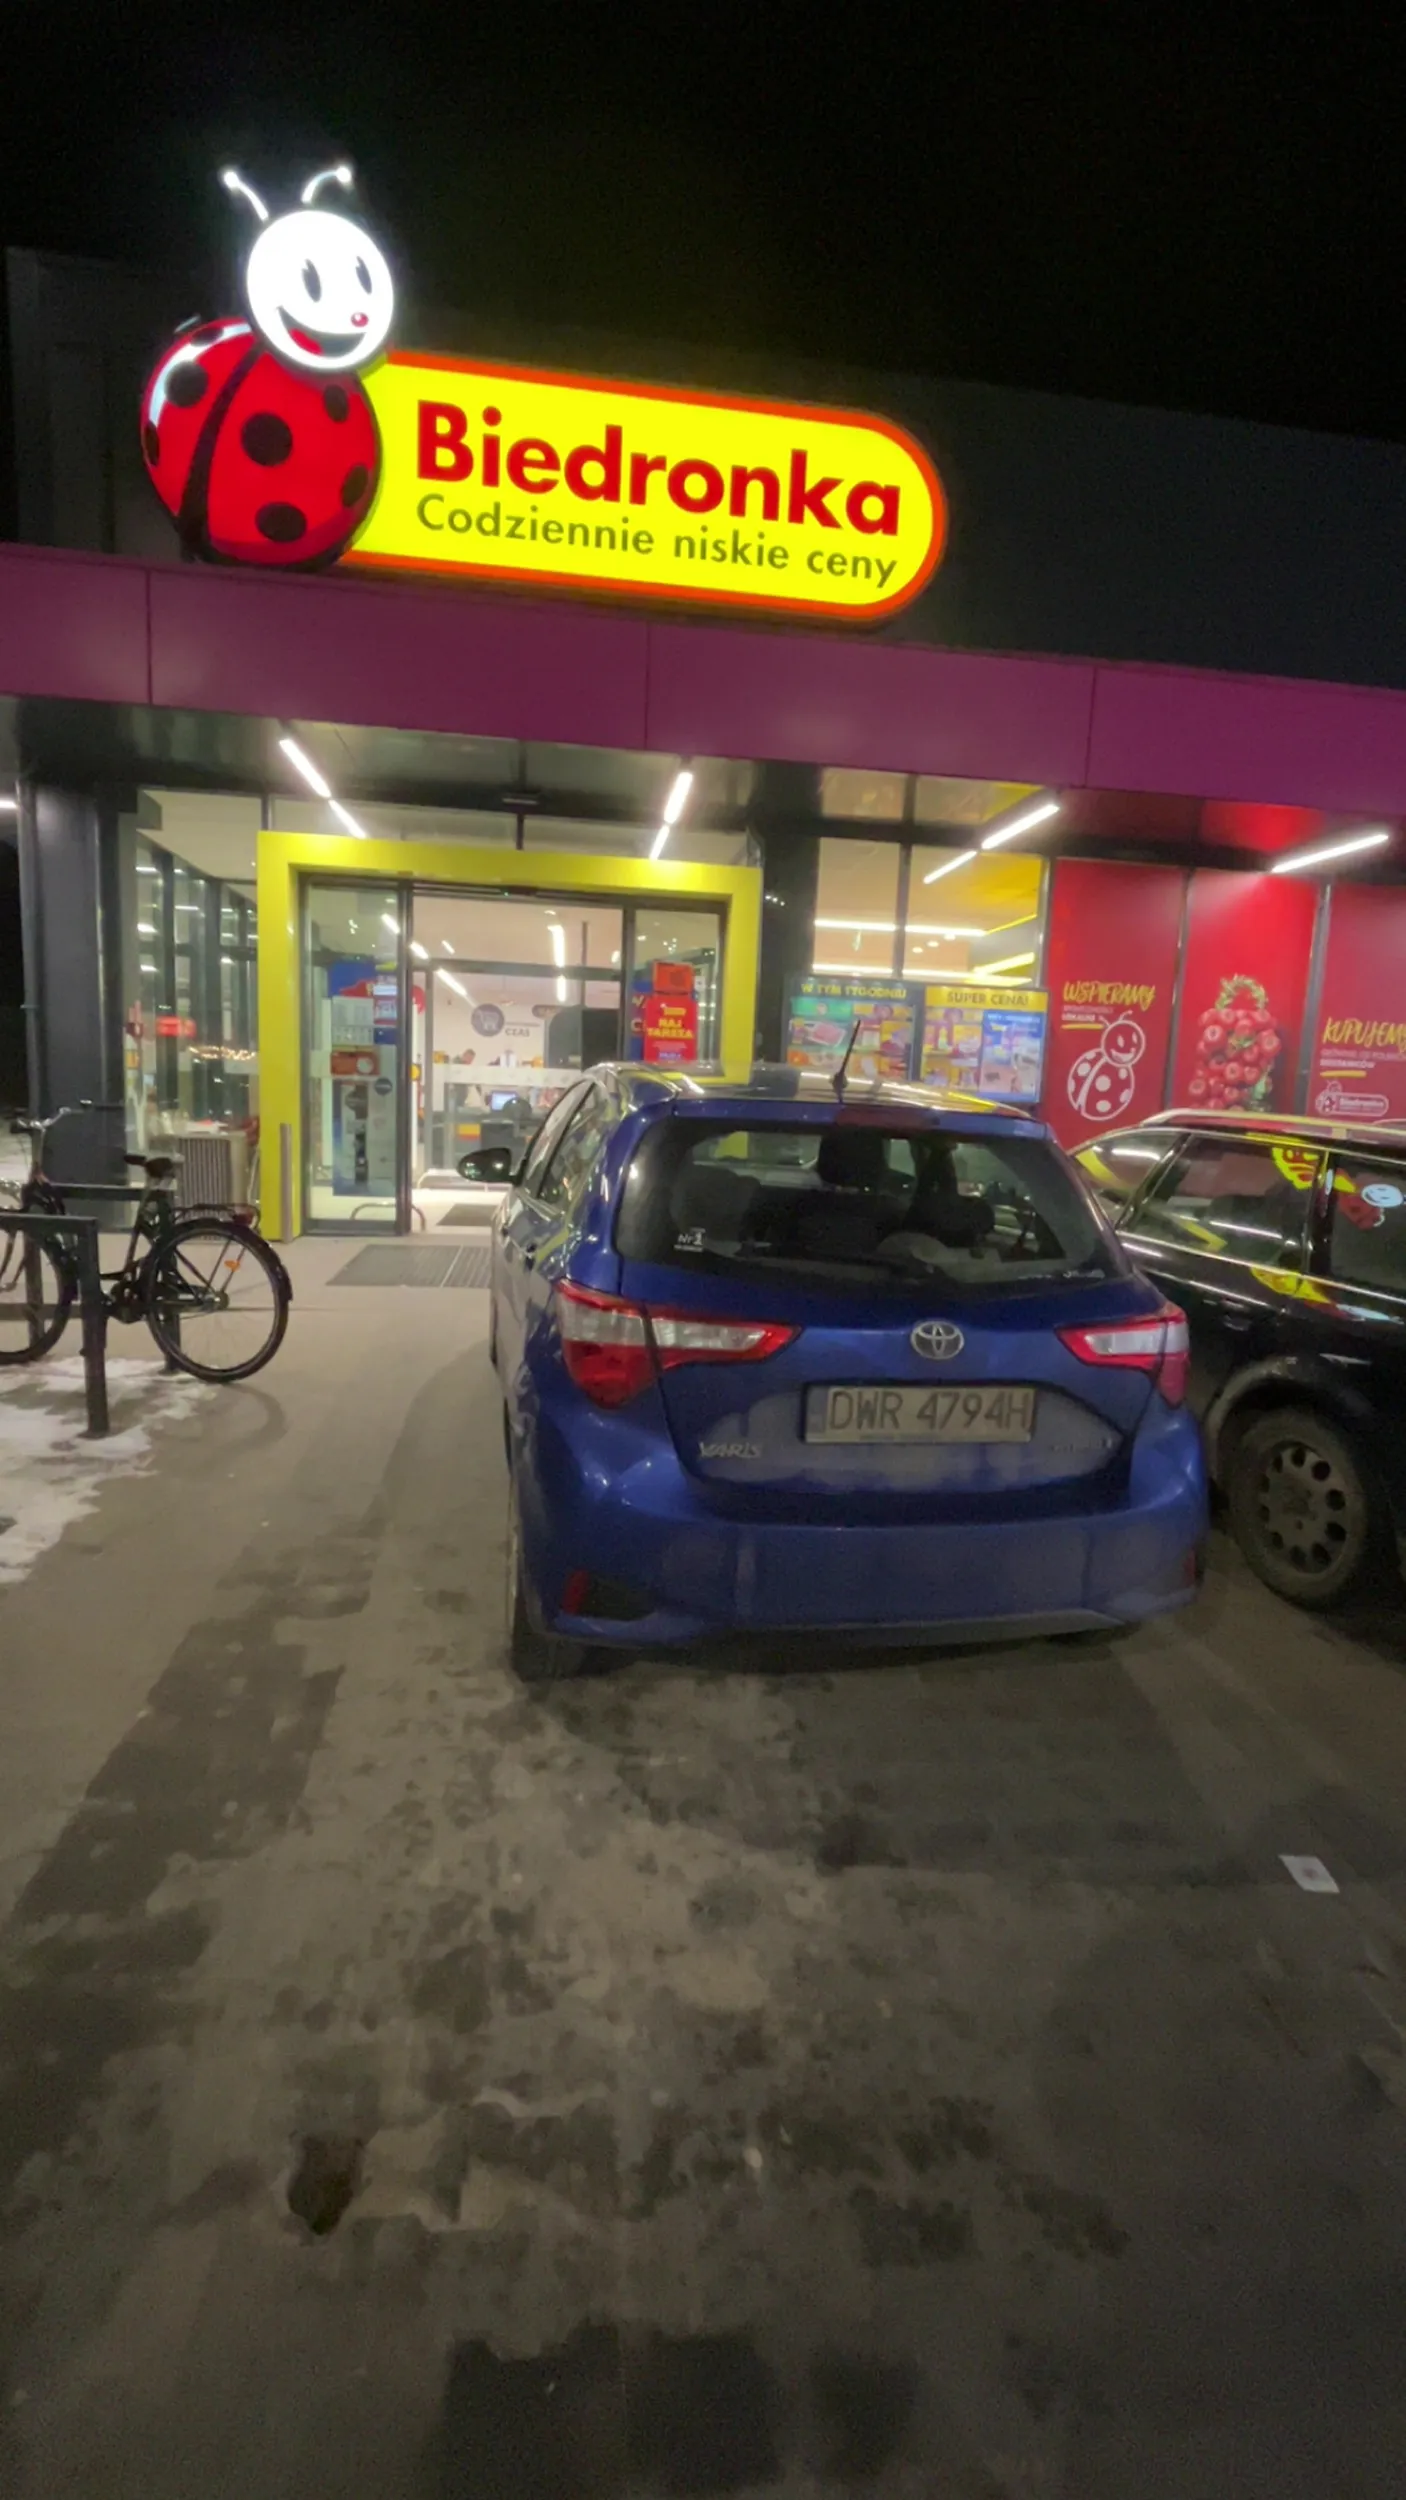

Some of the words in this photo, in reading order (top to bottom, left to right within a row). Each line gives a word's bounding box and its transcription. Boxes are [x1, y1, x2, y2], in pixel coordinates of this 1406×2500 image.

[416, 399, 901, 536] Biedronka
[416, 493, 655, 555] Codziennie
[673, 525, 789, 570] niskie
[805, 549, 898, 588] ceny
[801, 983, 814, 993] W
[947, 991, 985, 1004] SUPER
[1063, 980, 1155, 1011] WSPIERAMY
[830, 1391, 903, 1430] DWR
[916, 1391, 1030, 1430] 4794H
